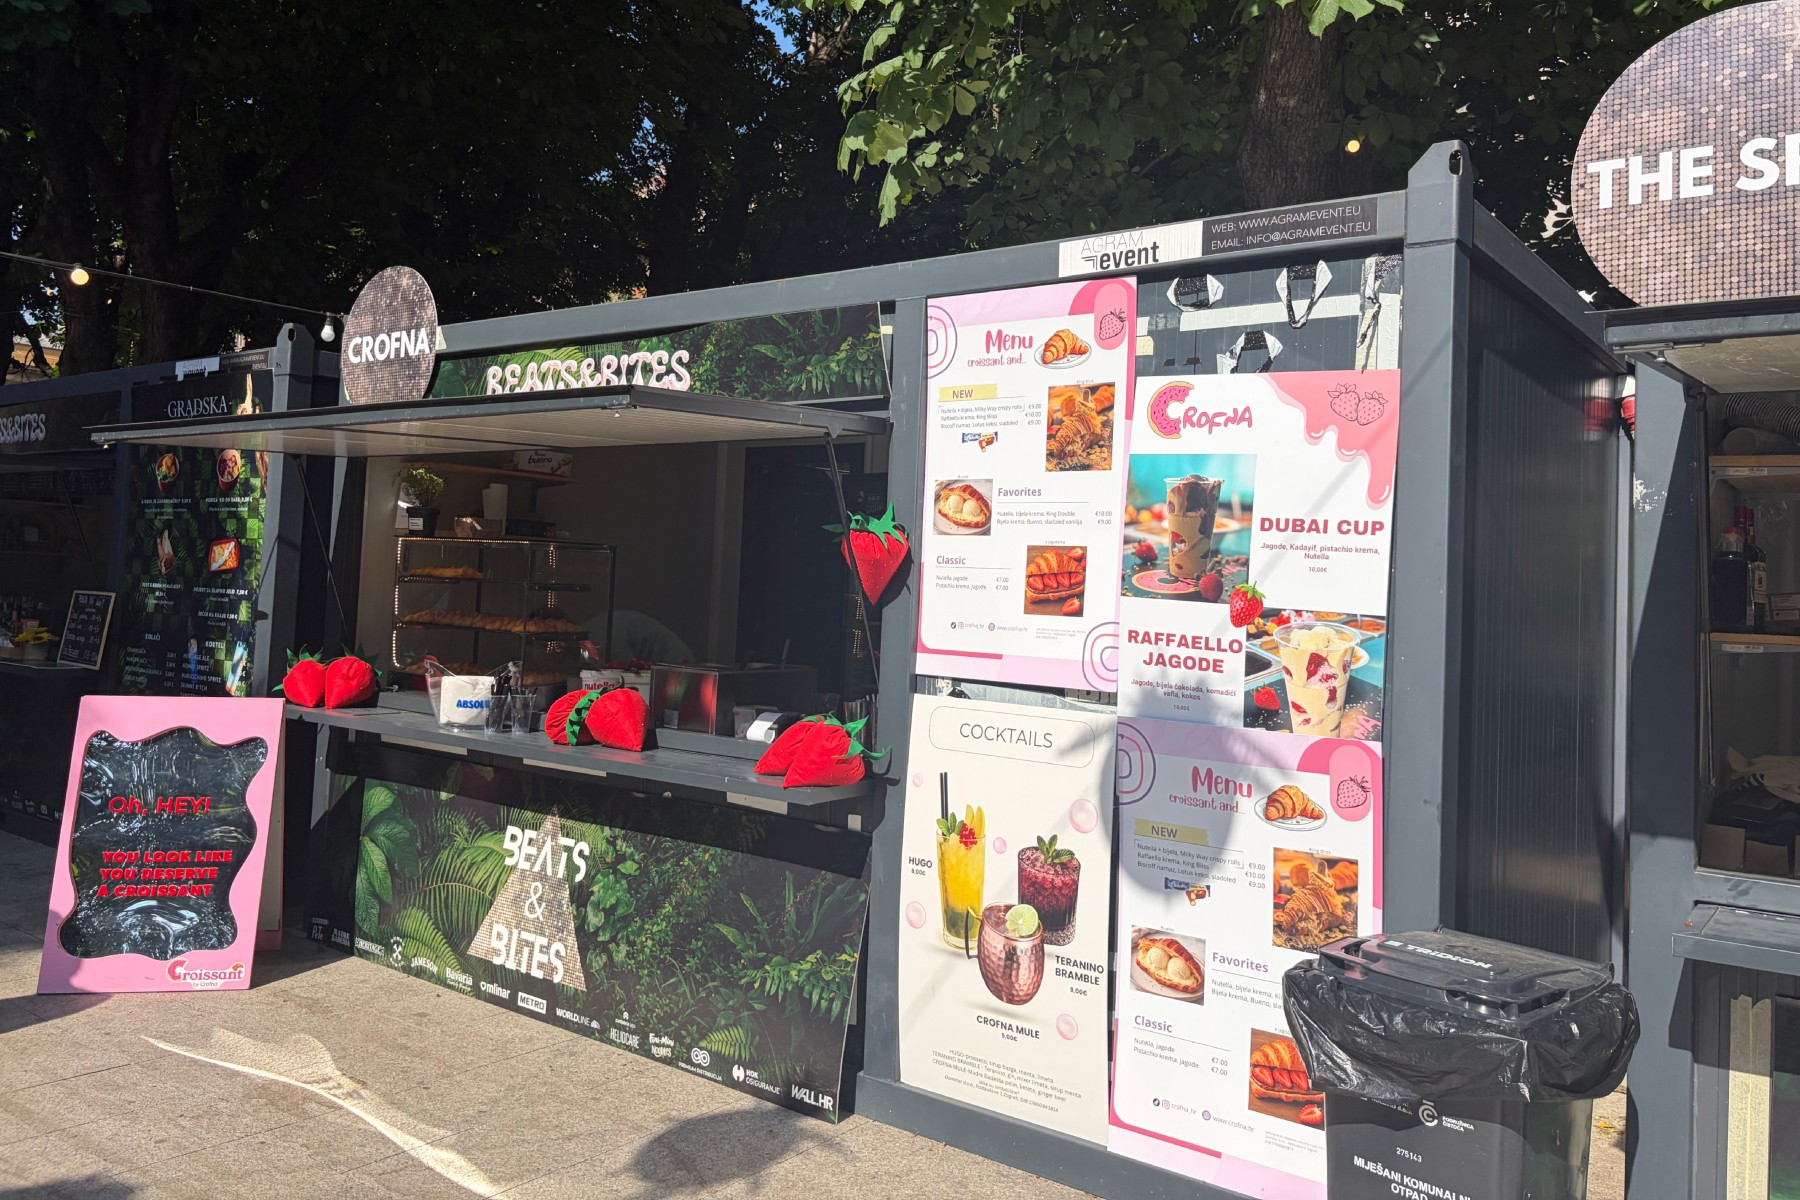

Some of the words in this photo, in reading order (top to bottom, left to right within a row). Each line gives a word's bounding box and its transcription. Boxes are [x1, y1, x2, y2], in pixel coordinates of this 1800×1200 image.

[1587, 145, 1713, 210] THE
[1211, 219, 1237, 234] WEB:
[1239, 205, 1361, 230] WWW.AGRAMEVENT.EU
[1080, 231, 1144, 255] AGRAM
[1211, 236, 1244, 251] EMAIL:
[1246, 220, 1371, 246] INFO@AGRAMEVENT.EU
[1099, 241, 1159, 270] event
[348, 327, 430, 363] CROFNA
[985, 329, 1034, 354] Menu
[968, 354, 1004, 367] croissant
[952, 389, 973, 399] NEW
[167, 396, 228, 418] GRADSKA
[998, 487, 1042, 497] Favorites
[1260, 517, 1328, 534] DUBAI
[1336, 520, 1385, 536] CUP
[1261, 542, 1288, 551] Jagode,
[1290, 544, 1318, 553] Kadayif,
[1320, 545, 1353, 554] pistachio
[1355, 546, 1380, 555] krema,
[1304, 552, 1330, 561] Nutella
[936, 555, 966, 565] Classic
[1128, 629, 1244, 654] RAFFAELLO
[1143, 652, 1224, 674] JAGODE
[1131, 678, 1155, 689] Jagode,
[1156, 680, 1173, 690] bijela
[1182, 692, 1201, 701] kokos
[960, 722, 1053, 749] COCKTAILS
[1192, 766, 1253, 799] Menu
[109, 796, 148, 817] Oh,
[156, 796, 211, 814] HEY!
[1169, 794, 1217, 810] croissant
[1151, 825, 1178, 839] NEW
[103, 852, 139, 863] YOU
[144, 851, 191, 863] LOOK
[195, 851, 233, 863] LIKE
[503, 825, 590, 883] BEATS
[908, 856, 933, 869] HUGO
[1137, 843, 1157, 853] Nutella
[1180, 850, 1195, 860] Milky
[1196, 852, 1209, 862] Way
[1209, 856, 1227, 866] crispy
[1228, 857, 1241, 867] rolls
[1248, 863, 1266, 871] €9.00
[100, 869, 136, 880] YOU
[141, 868, 218, 880] DESERVE
[1138, 853, 1161, 863] Raffaello
[1162, 857, 1181, 867] krema,
[1182, 860, 1195, 870] King
[1196, 862, 1210, 871] Bliss
[1245, 871, 1266, 881] €10.00
[1138, 861, 1156, 870] Biscoff
[1178, 868, 1194, 877] Lotus
[1211, 874, 1237, 884] sladoled
[1248, 881, 1266, 890] €9.00
[96, 886, 108, 897] A
[113, 884, 214, 897] CROISSANT
[525, 882, 546, 921] &
[491, 923, 566, 984] BITES
[1212, 952, 1269, 973] Favorites
[1406, 944, 1493, 970] TRIDION
[168, 960, 244, 981] Croissant
[410, 956, 439, 975] JAMESON
[1055, 955, 1105, 974] TERANINO
[446, 966, 473, 986] Bavaria
[1055, 968, 1100, 986] BRAMBLE
[486, 982, 510, 1000] mlinar
[1212, 979, 1234, 990] Nutella,
[1235, 984, 1252, 994] bijela
[1252, 988, 1274, 999] krema,
[1212, 988, 1229, 999] Bijela
[1229, 992, 1250, 1003] krema,
[1250, 997, 1272, 1008] Bueno,
[519, 995, 545, 1012] METRO
[556, 1007, 590, 1027] WORLDLINE
[1134, 1015, 1173, 1034] Classic
[976, 1015, 1014, 1032] CROFNA
[1016, 1025, 1040, 1040] MULE
[610, 1028, 640, 1049] HELIOCARE
[1134, 1037, 1155, 1049] Nutella,
[1155, 1042, 1175, 1054] jagode
[1211, 1057, 1228, 1067] €7.00
[1134, 1047, 1159, 1060] Pistachio
[1159, 1054, 1179, 1065] krema,
[1179, 1058, 1200, 1070] jagode
[1211, 1066, 1228, 1077] €7.00
[746, 1069, 759, 1079] HOK
[746, 1076, 781, 1095] OSIGURANJE
[791, 1084, 834, 1111] WALL.HR
[1172, 1103, 1197, 1116] crofna_hr
[1213, 1115, 1255, 1133] www.crofna.hr
[1396, 1147, 1423, 1163] 275143
[1354, 1155, 1402, 1183] MIJEŠANI
[1391, 1182, 1429, 1200] OTPAD
